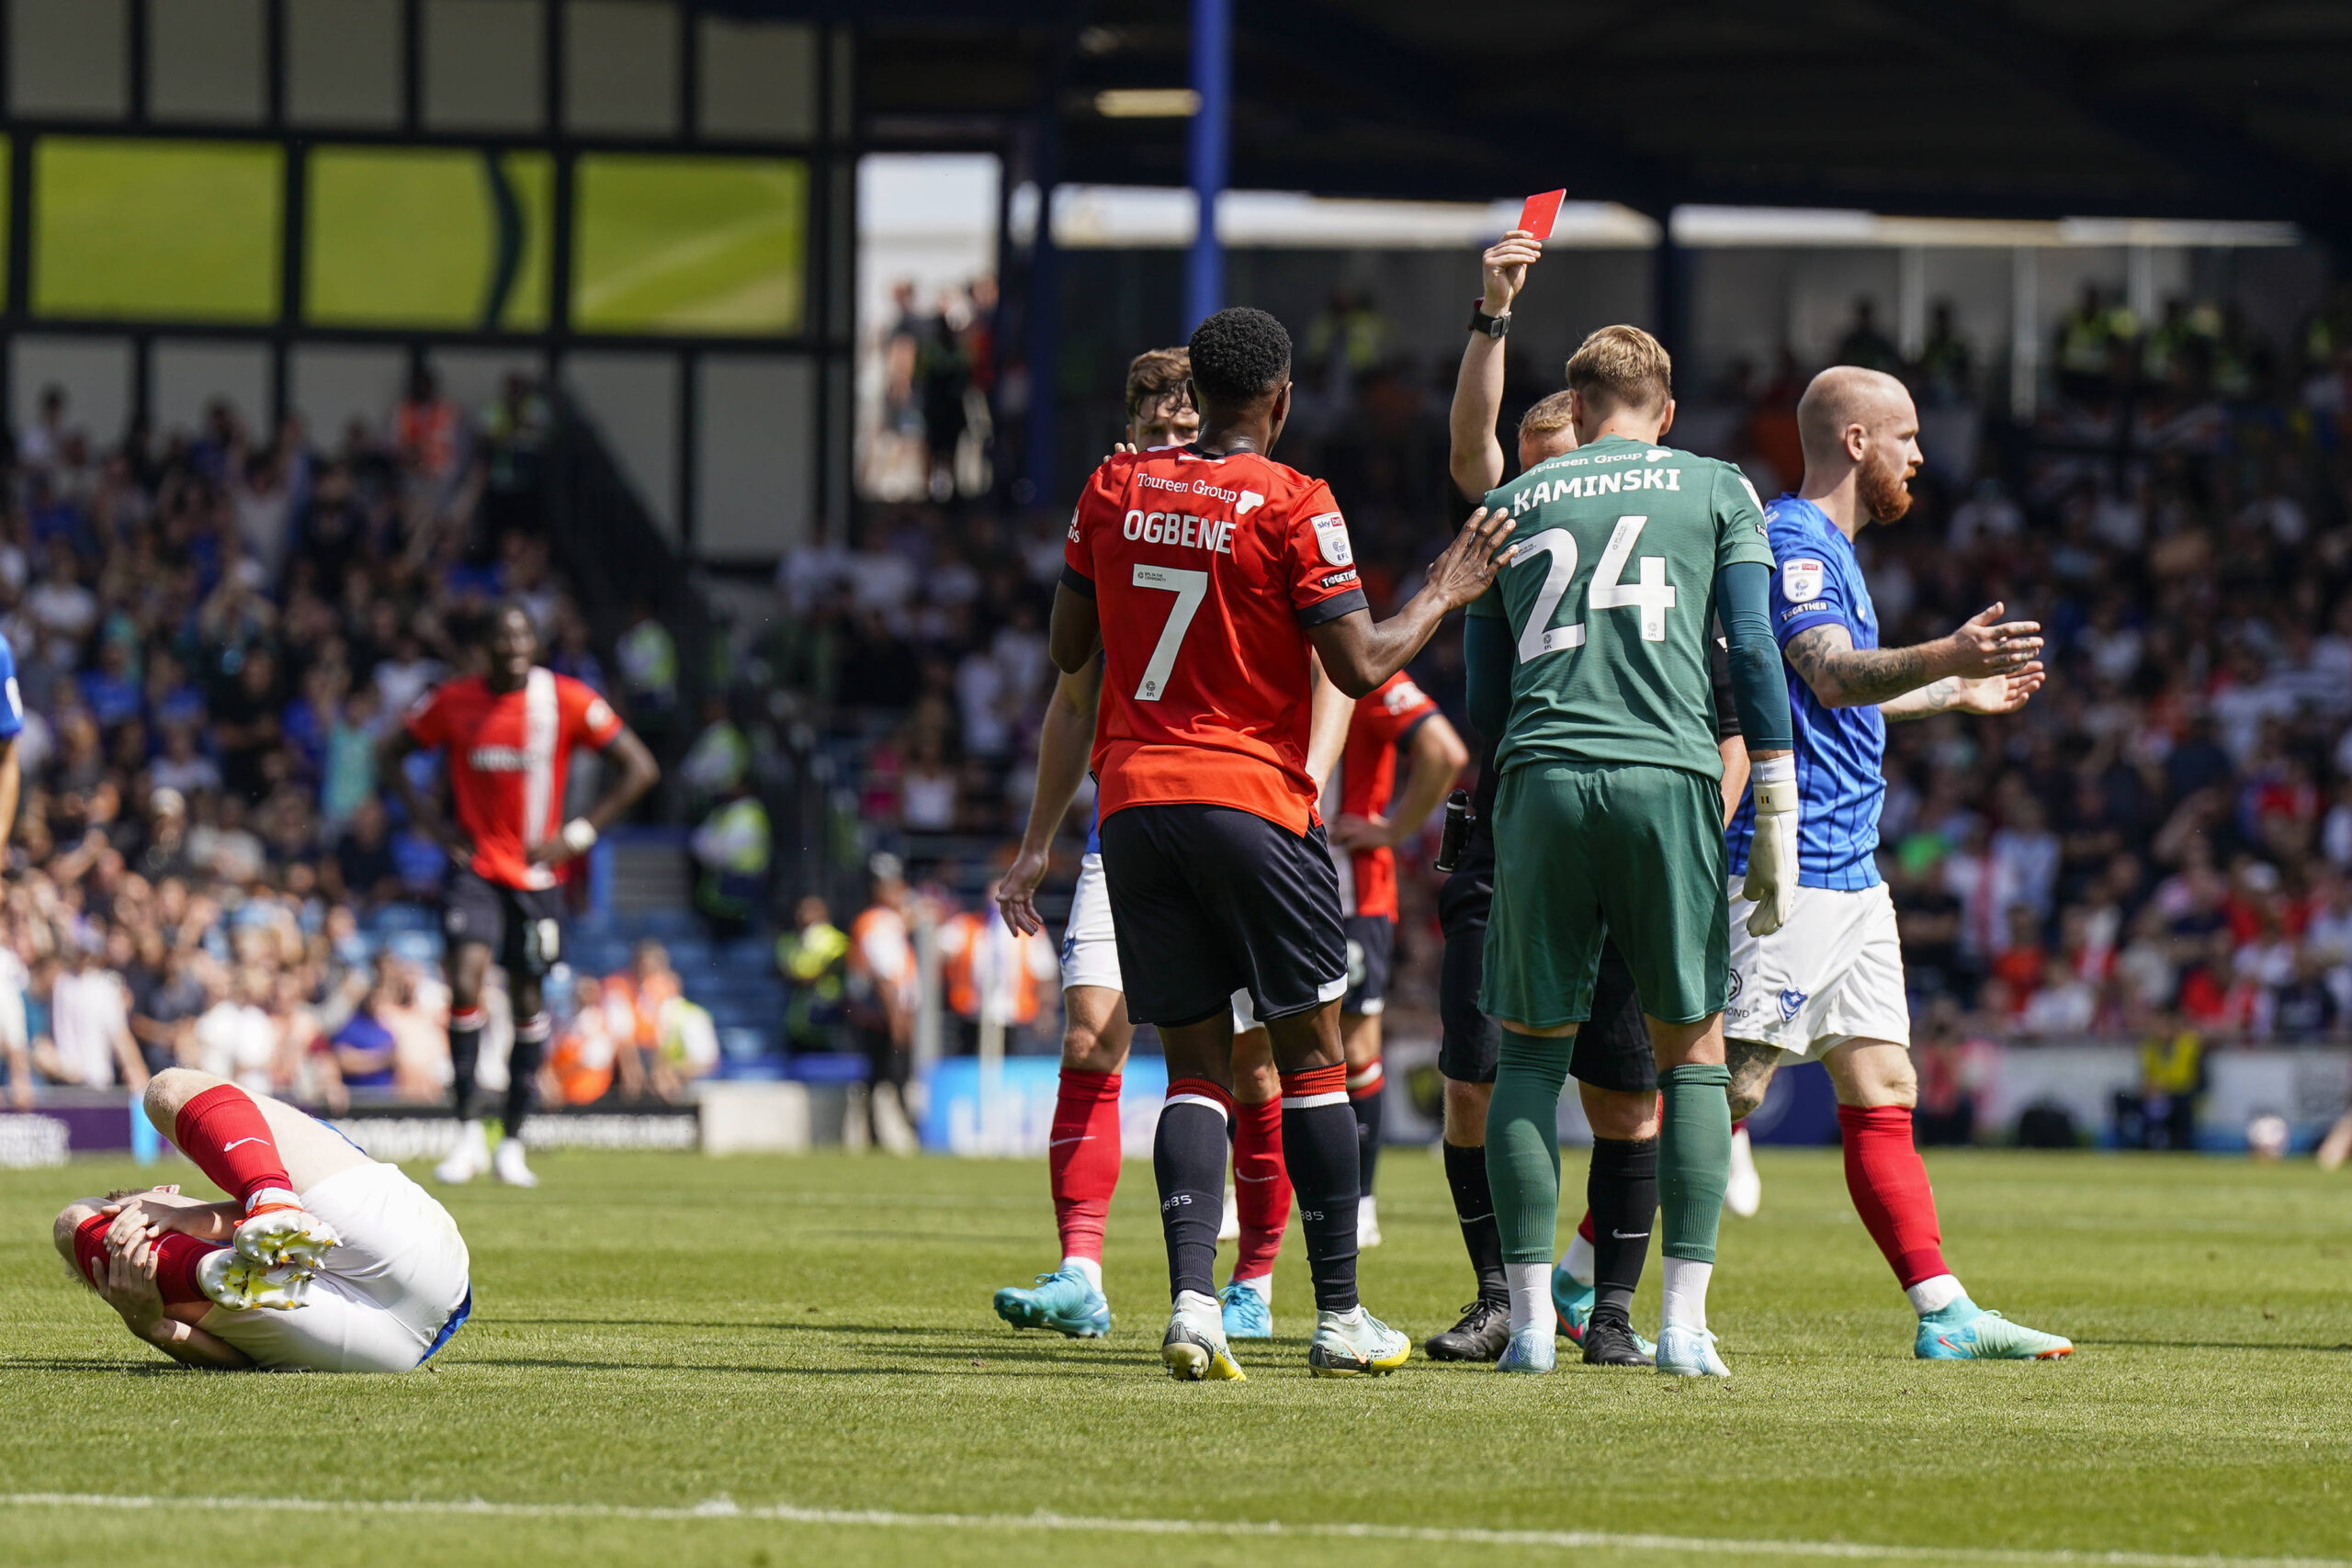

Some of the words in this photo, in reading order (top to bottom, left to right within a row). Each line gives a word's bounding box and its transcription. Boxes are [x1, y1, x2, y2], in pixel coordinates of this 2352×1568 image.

[1529, 457, 1589, 476] Toureen
[1594, 452, 1643, 464] Group
[1137, 473, 1189, 493] Toureen
[1193, 479, 1238, 503] Group
[1513, 468, 1680, 517] KAMINSKI
[1124, 509, 1237, 554] OGBENE
[1337, 552, 1350, 561] EFL
[1510, 514, 1676, 665] 24
[1133, 563, 1208, 701] 7
[1162, 1194, 1193, 1213] 1885
